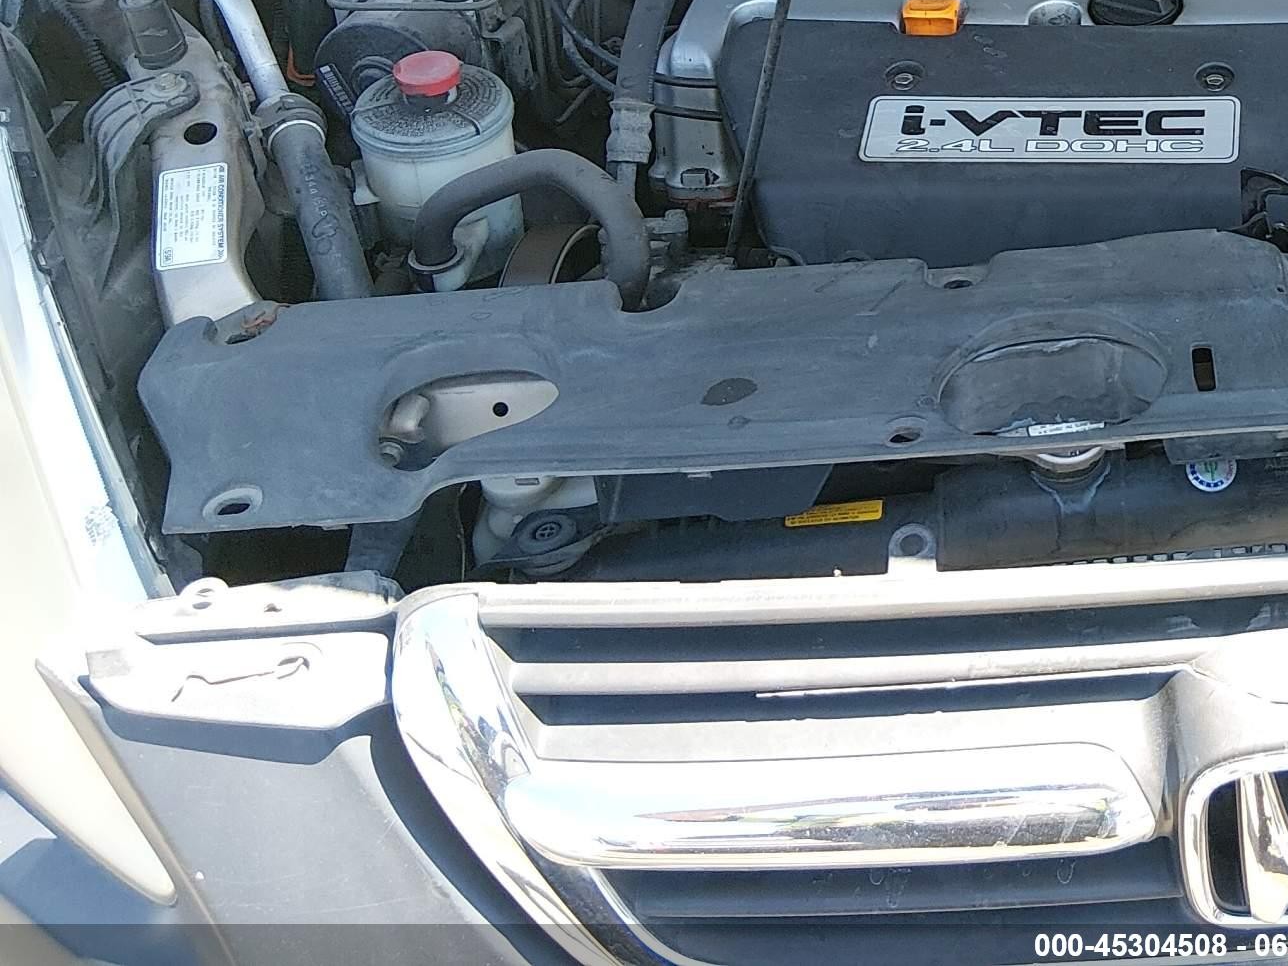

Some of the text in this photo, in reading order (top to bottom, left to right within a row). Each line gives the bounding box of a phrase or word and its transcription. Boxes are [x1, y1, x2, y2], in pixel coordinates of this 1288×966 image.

[900, 105, 1206, 136] i-VTEC
[896, 138, 1204, 153] 2.4L DOHC
